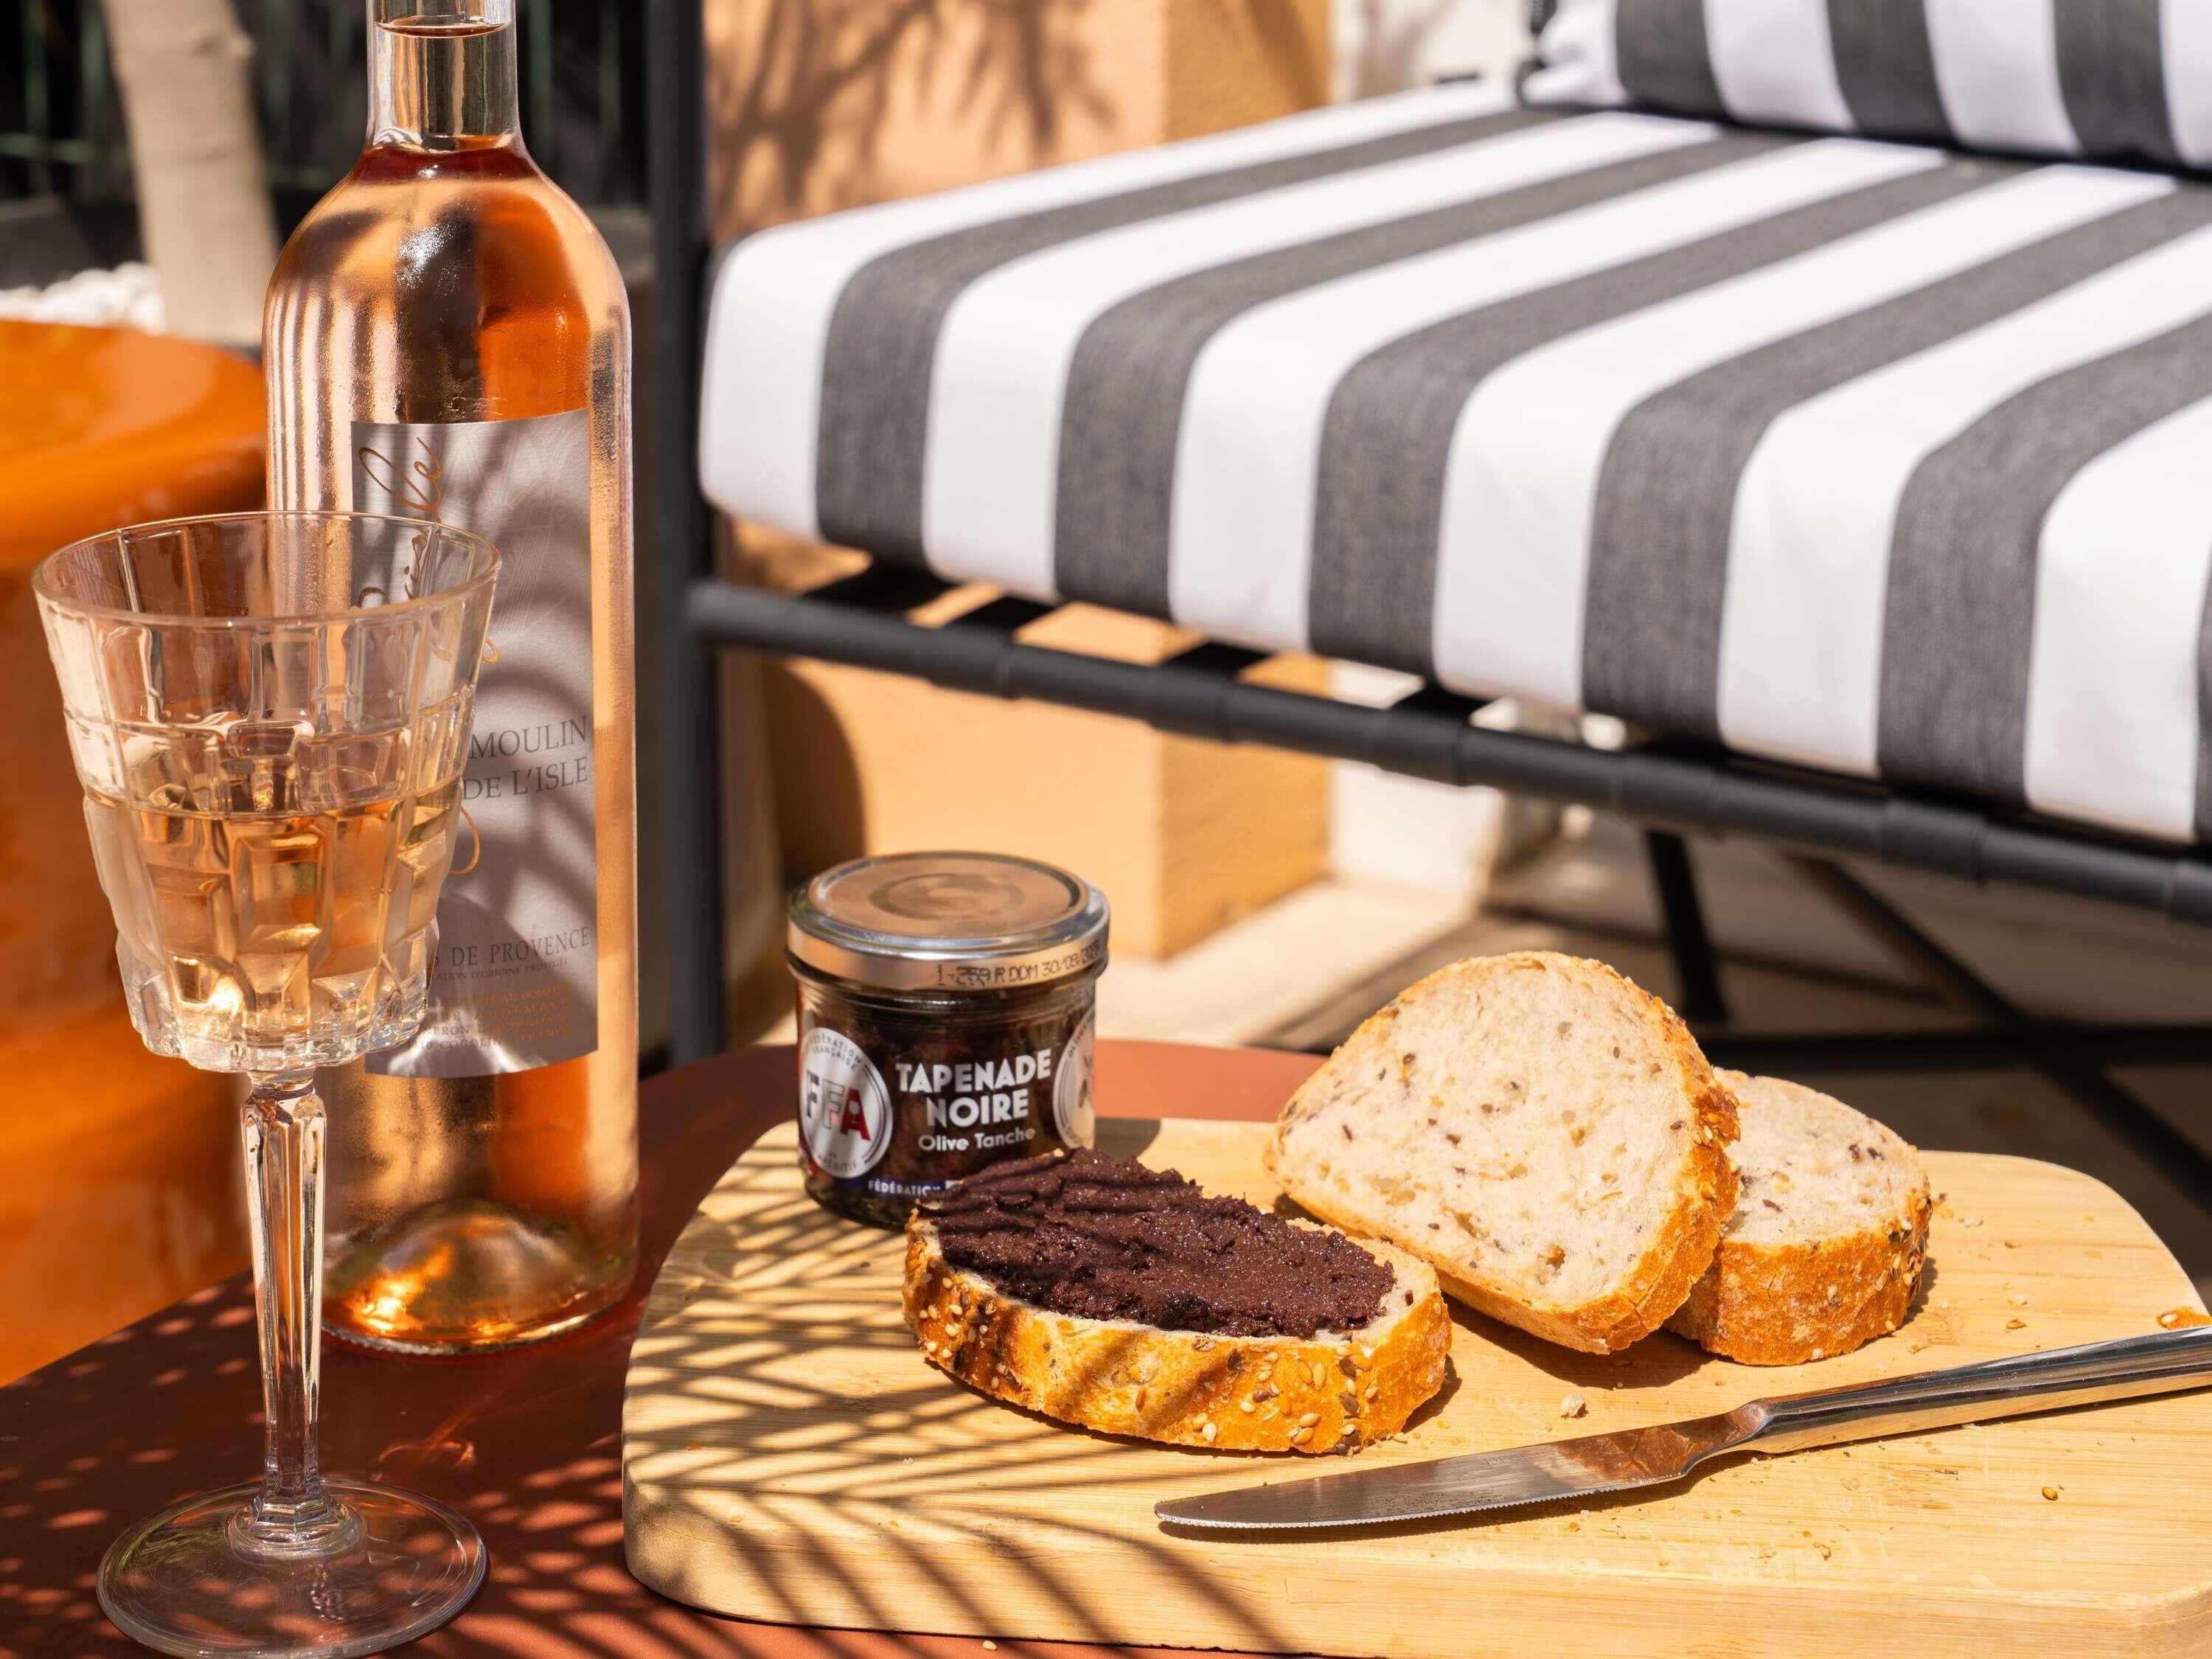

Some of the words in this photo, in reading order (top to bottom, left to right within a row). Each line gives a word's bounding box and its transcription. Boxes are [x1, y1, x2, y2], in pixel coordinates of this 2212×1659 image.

[468, 716, 588, 759] MOULIN
[463, 776, 501, 800] DE
[512, 756, 589, 796] L'ISLE
[452, 946, 479, 967] DE
[490, 926, 591, 964] PROVENCE
[1009, 964, 1038, 982] DDM
[895, 1048, 1052, 1093] TAPENADE
[806, 1069, 872, 1141] FFA
[927, 1088, 1029, 1127] NOIRE
[918, 1133, 968, 1152] Olive
[976, 1127, 1036, 1150] Tanche
[867, 1178, 942, 1197] FÉDÉRATIO
